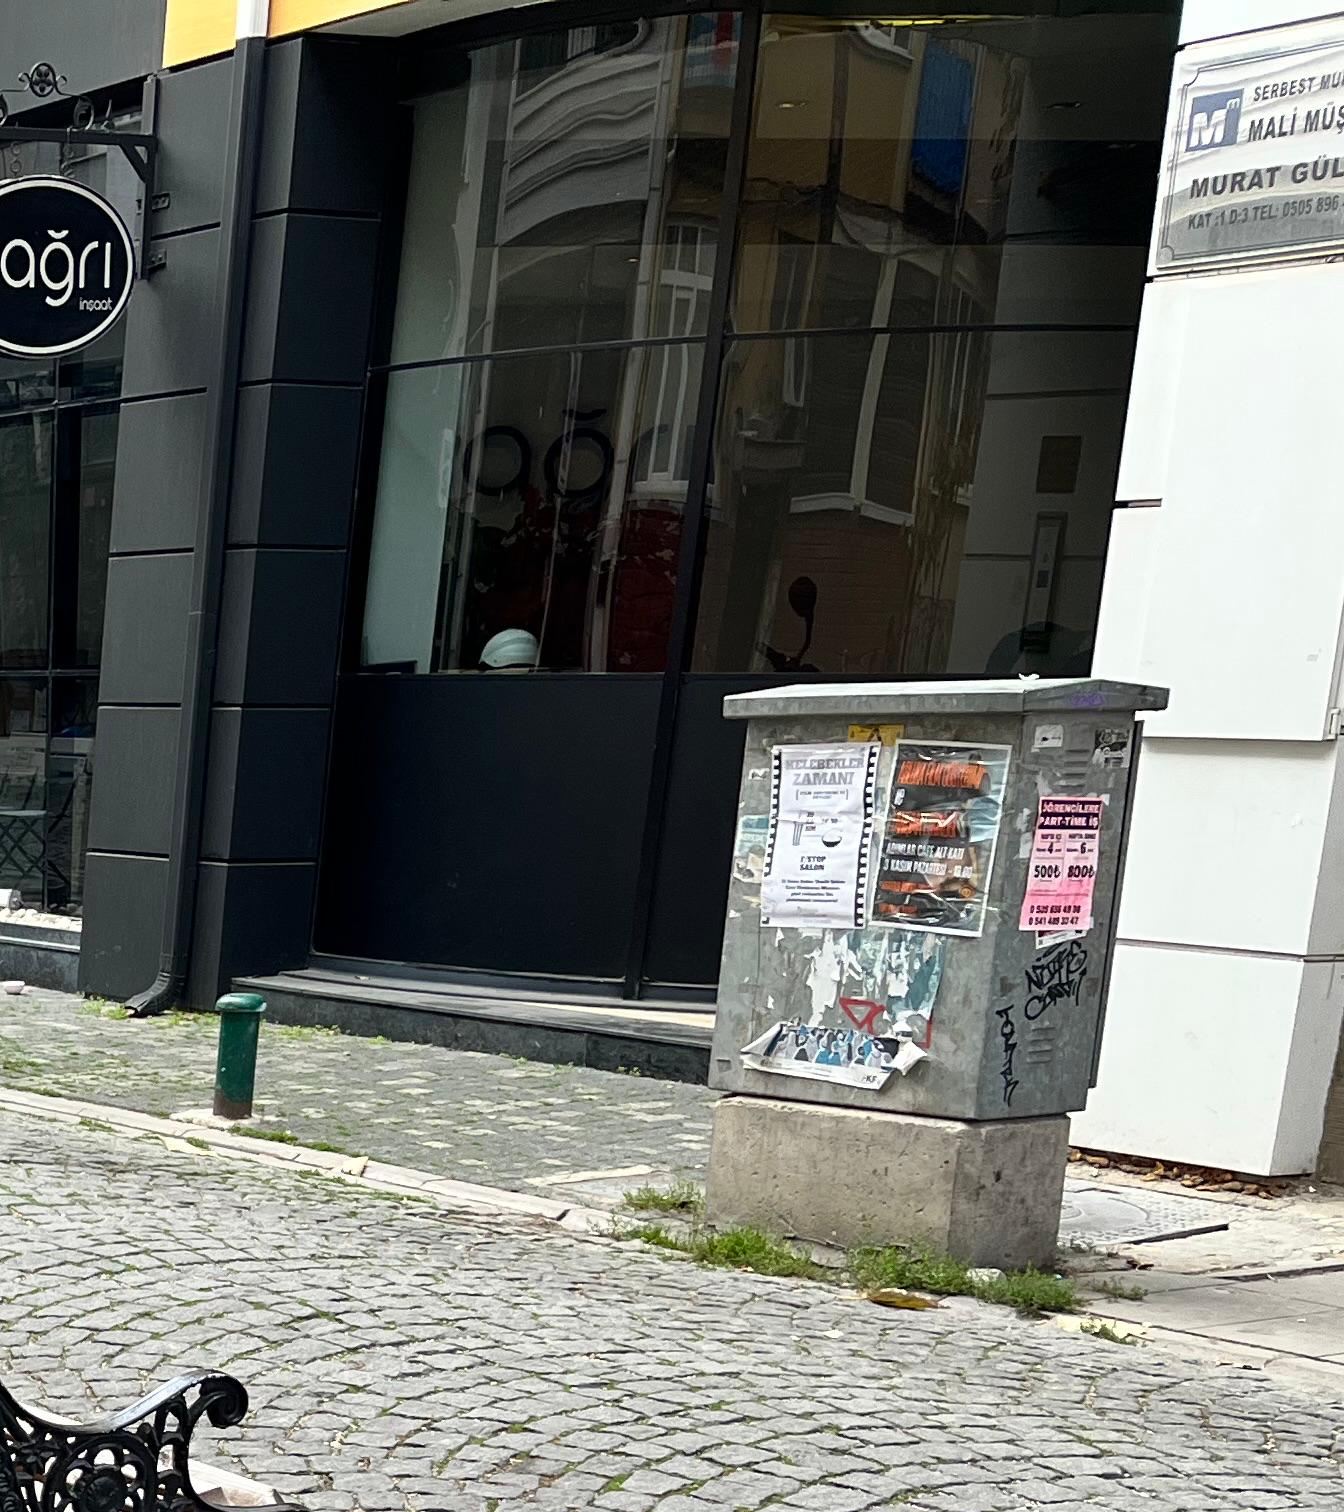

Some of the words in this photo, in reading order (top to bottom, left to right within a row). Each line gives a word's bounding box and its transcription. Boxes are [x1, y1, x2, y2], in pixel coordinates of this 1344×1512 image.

[1253, 77, 1317, 102] SERBEST
[1247, 106, 1297, 143] MALİ
[1189, 166, 1282, 200] MURAT
[1188, 211, 1212, 230] KAT
[1282, 198, 1312, 218] 0505
[79, 297, 113, 312] inşaat
[792, 771, 855, 786] ZAMANI
